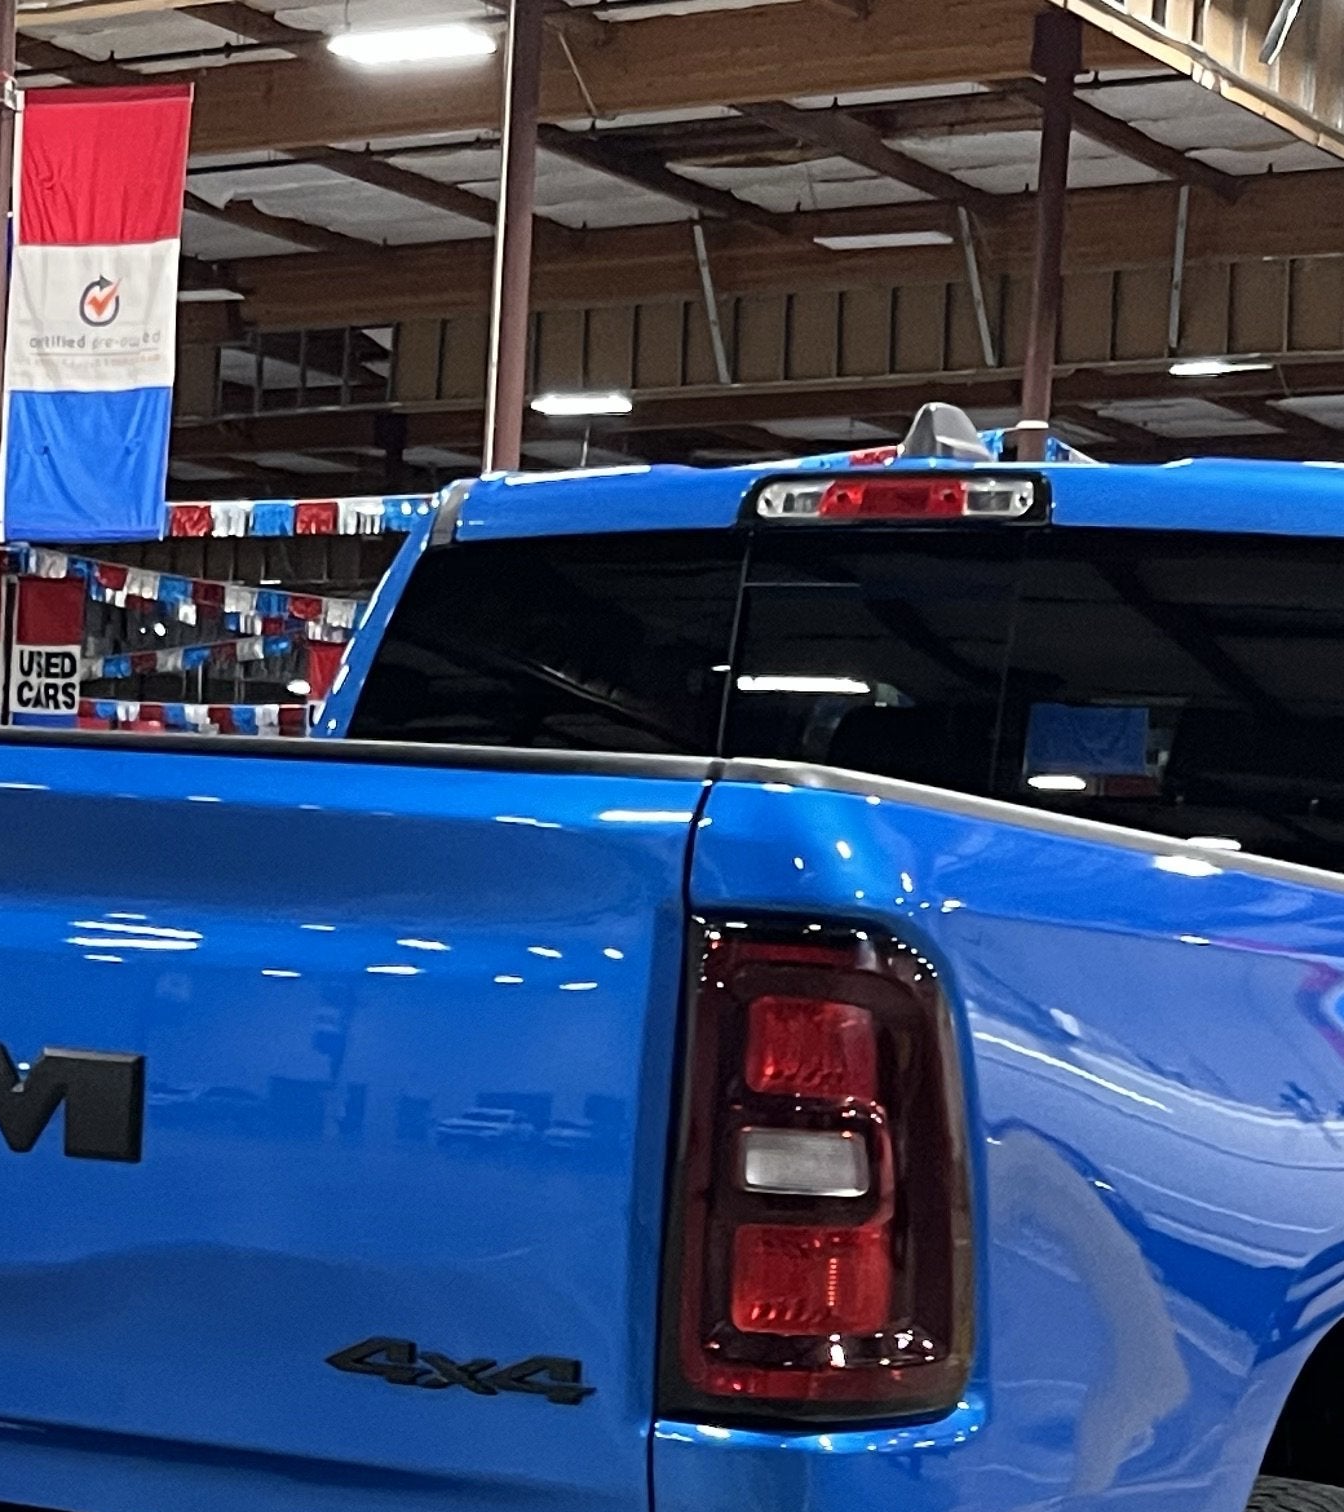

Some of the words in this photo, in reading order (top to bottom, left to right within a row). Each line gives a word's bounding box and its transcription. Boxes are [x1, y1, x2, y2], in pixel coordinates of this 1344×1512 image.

[19, 650, 77, 679] USED
[17, 681, 76, 709] CARS
[325, 1337, 597, 1405] 4x4
